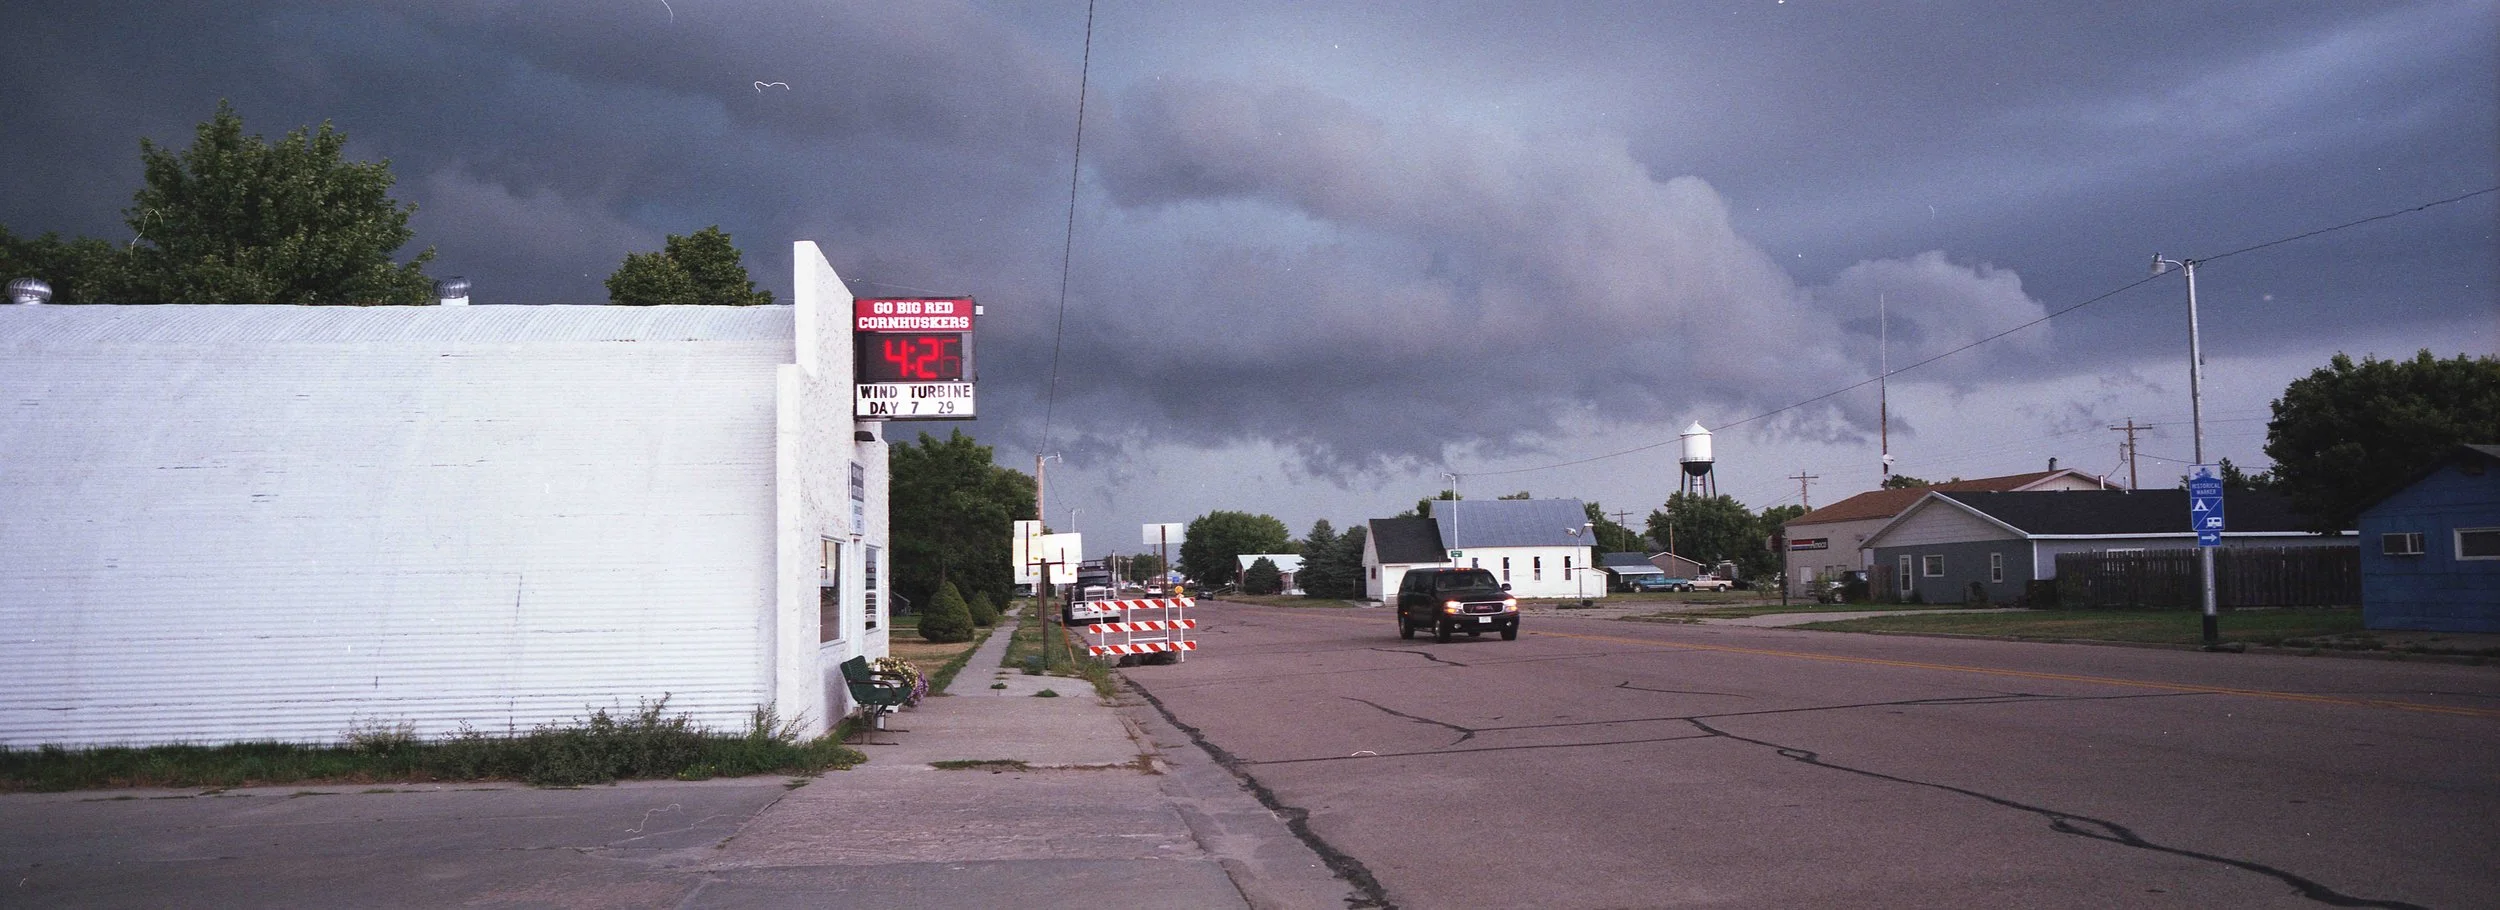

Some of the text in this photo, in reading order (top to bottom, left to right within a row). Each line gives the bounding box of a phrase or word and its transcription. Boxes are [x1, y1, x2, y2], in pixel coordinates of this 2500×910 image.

[873, 302, 954, 314] GO BIG RED
[858, 317, 969, 329] CORNHUSKERS
[860, 385, 971, 399] WIND TURBINE
[869, 401, 954, 415] DAY 7 29
